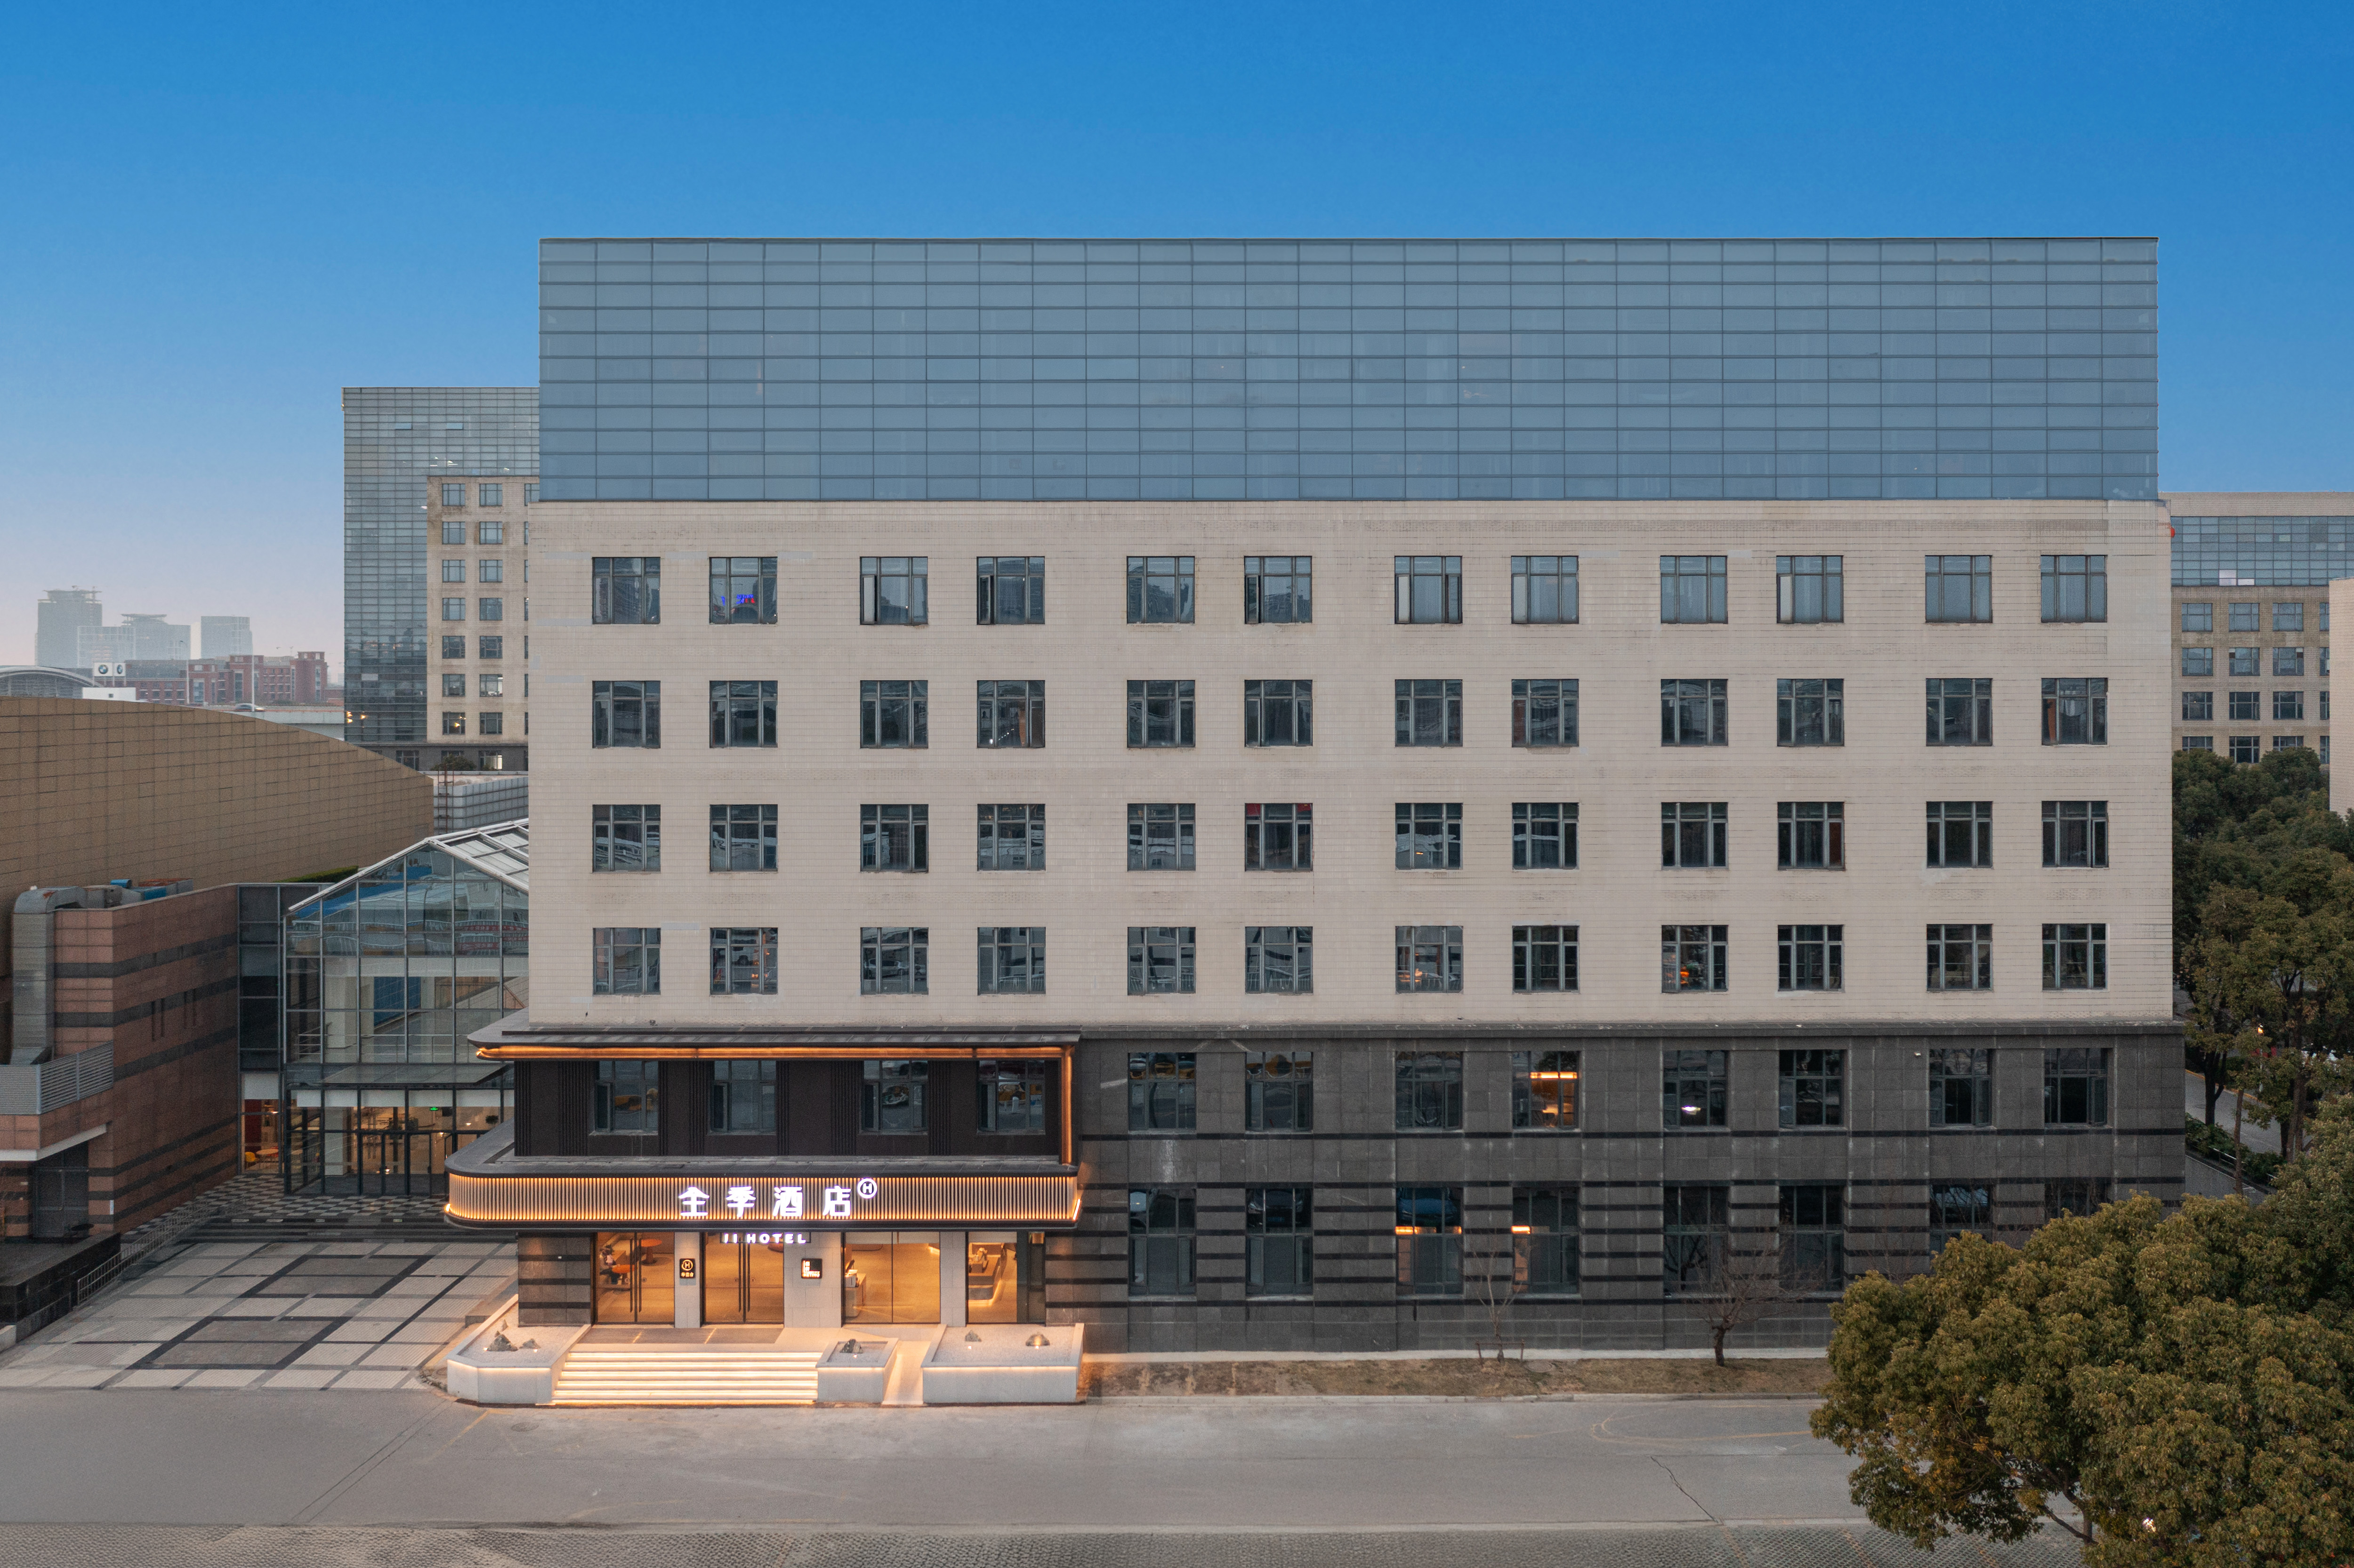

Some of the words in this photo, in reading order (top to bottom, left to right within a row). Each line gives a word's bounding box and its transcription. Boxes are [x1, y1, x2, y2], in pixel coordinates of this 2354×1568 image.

[678, 1185, 851, 1217] 全季酒店
[746, 1232, 806, 1244] HOTEL
